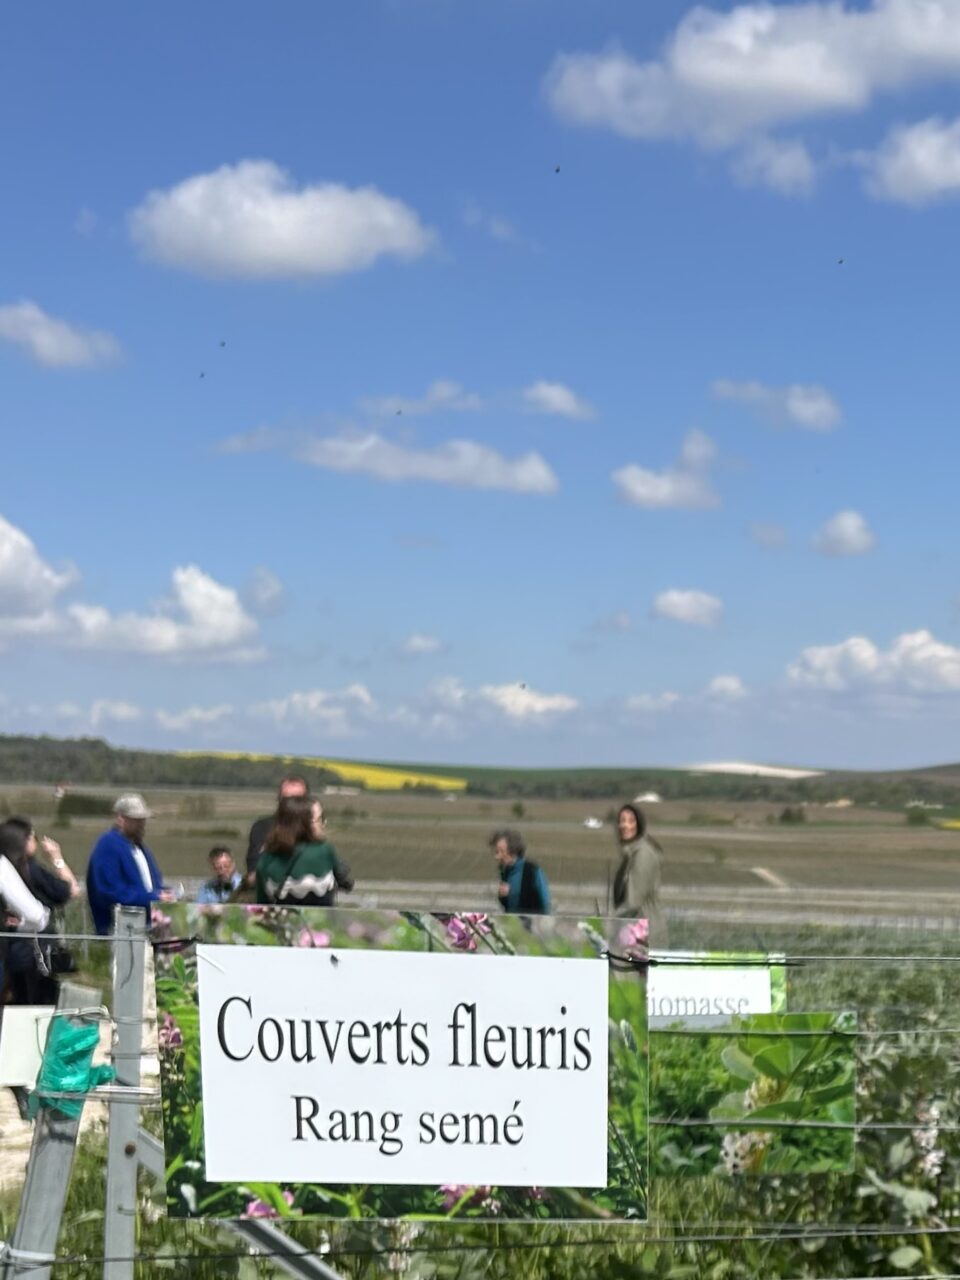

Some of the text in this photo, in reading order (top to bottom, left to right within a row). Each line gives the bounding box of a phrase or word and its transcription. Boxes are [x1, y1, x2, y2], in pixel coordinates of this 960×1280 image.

[649, 986, 750, 1015] iomasse
[216, 996, 592, 1071] Couverts fleuris
[291, 1095, 525, 1156] Rang semé
